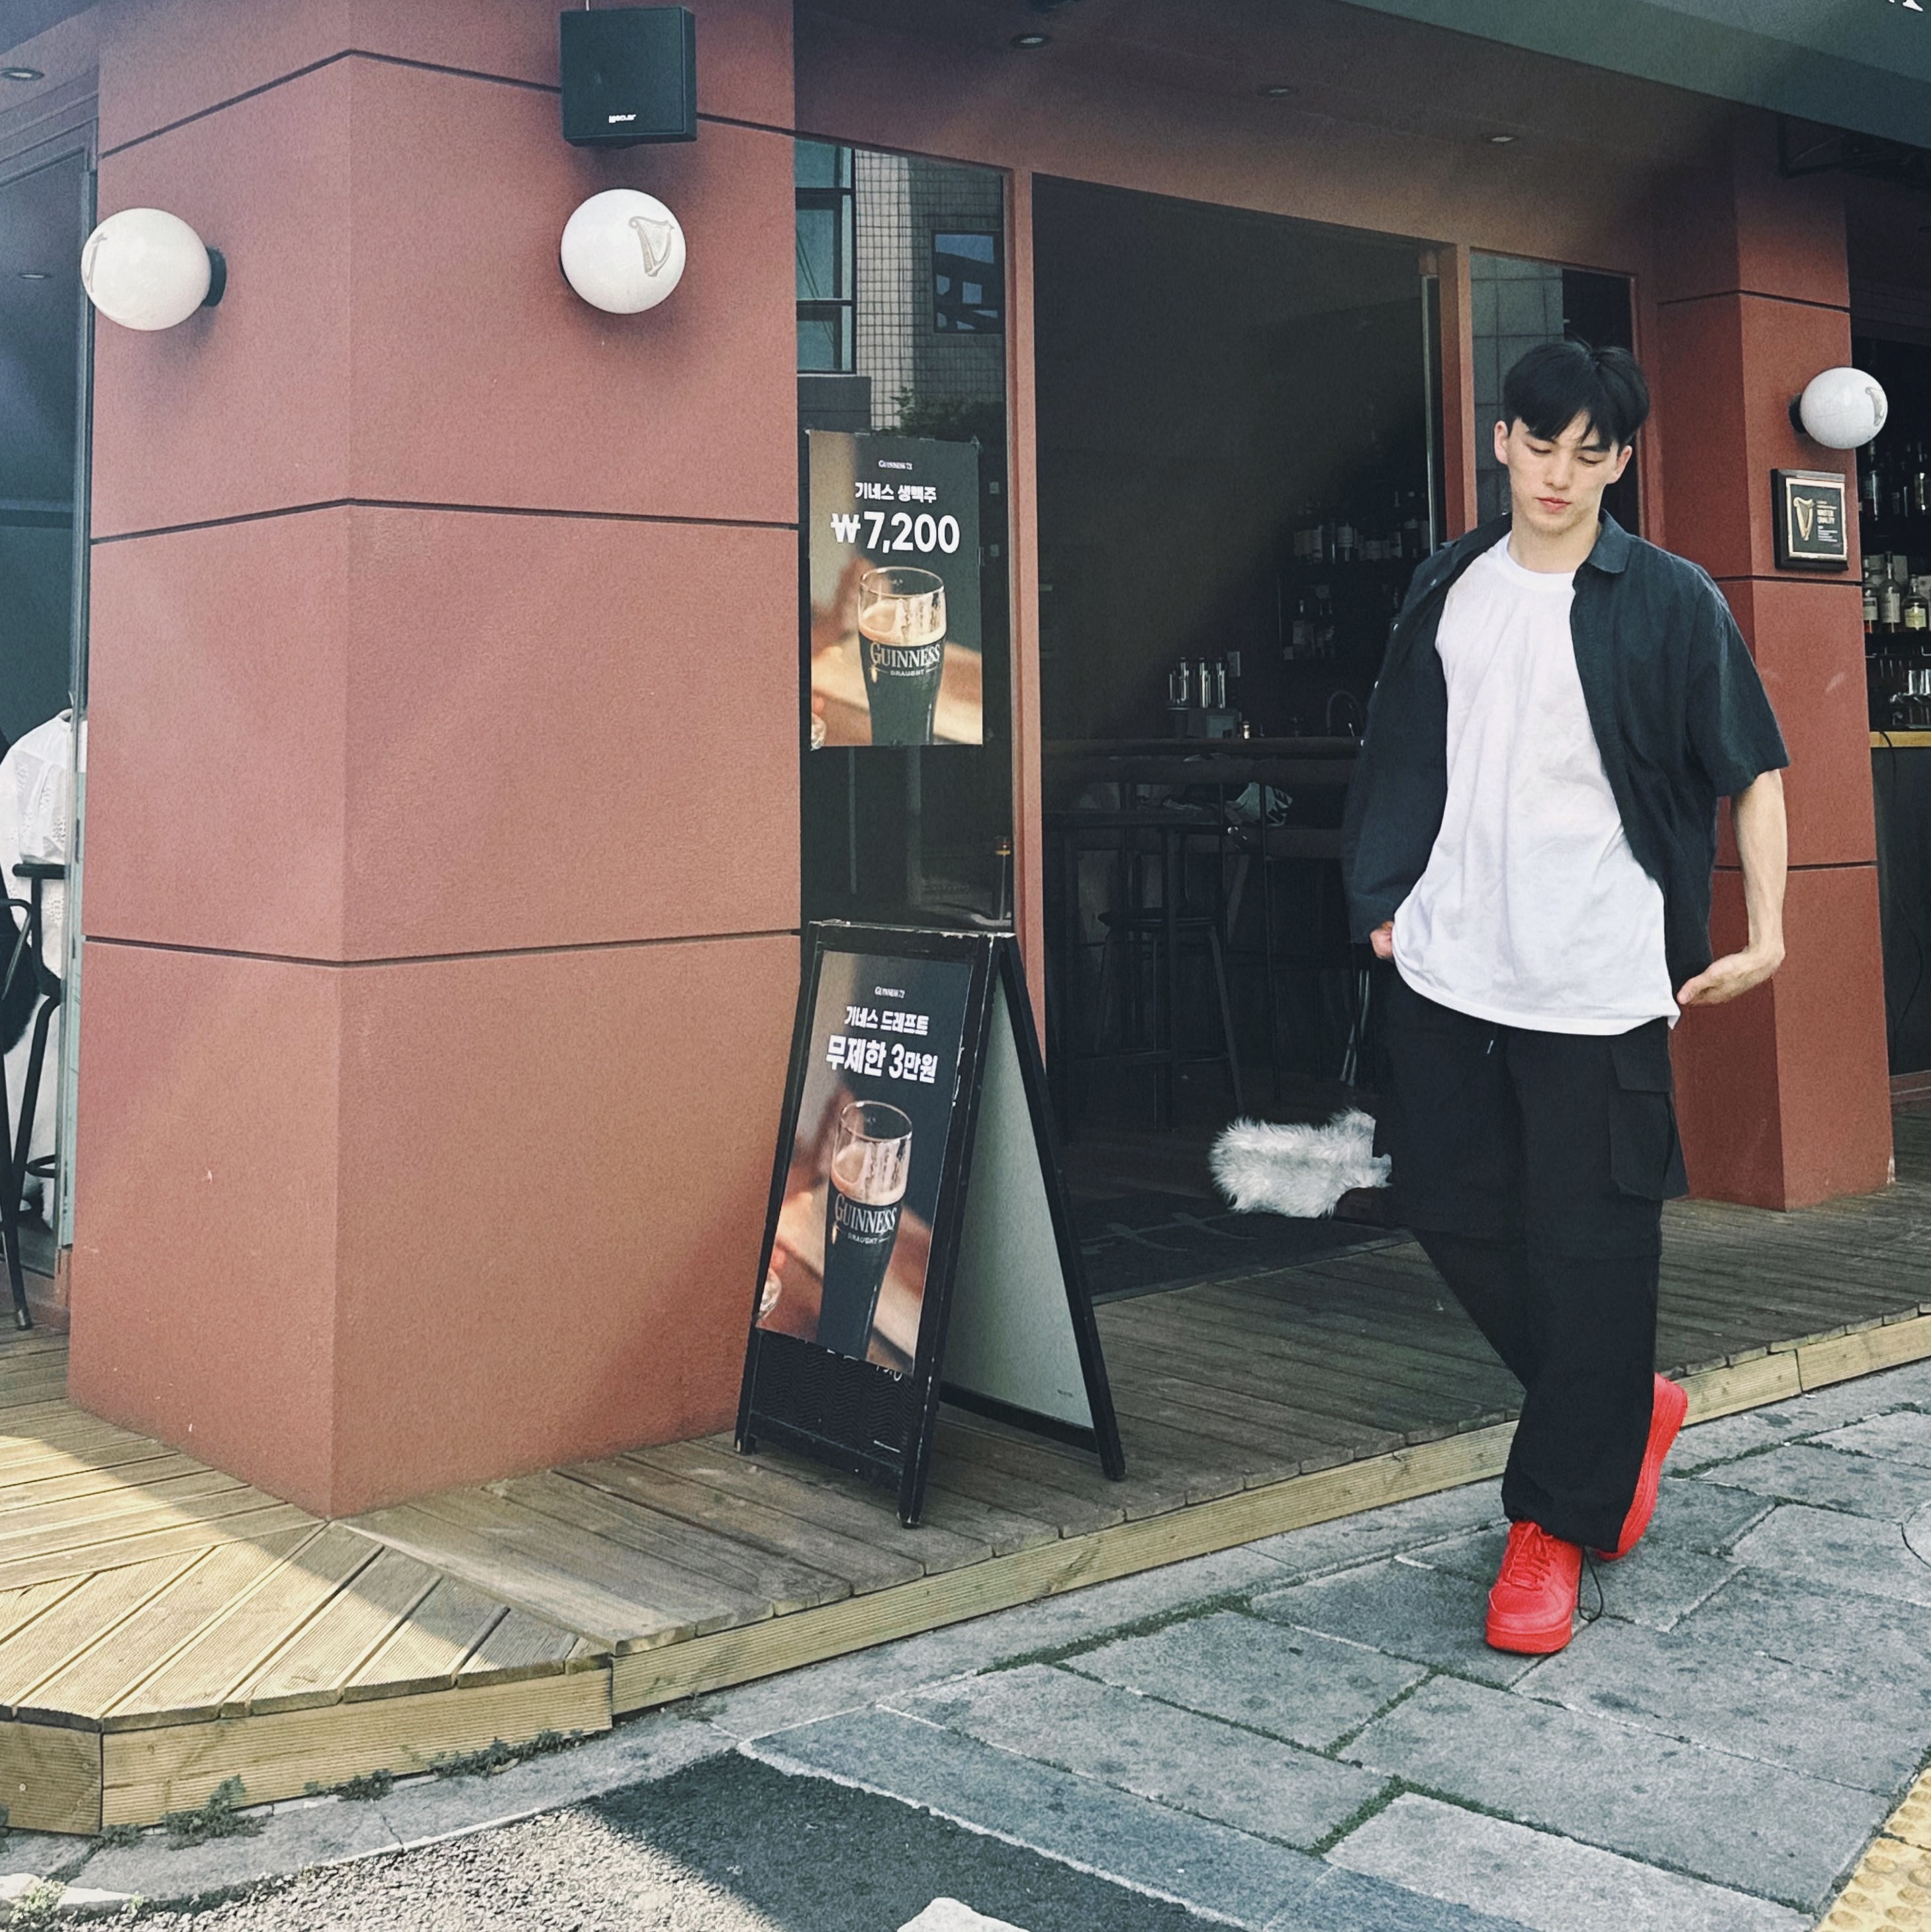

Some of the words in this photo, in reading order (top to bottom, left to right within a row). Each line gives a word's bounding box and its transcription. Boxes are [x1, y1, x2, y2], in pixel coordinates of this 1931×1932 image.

[855, 482, 894, 500] 기네스
[898, 484, 937, 503] 생맥주
[830, 511, 960, 554] ₩7,200
[870, 641, 941, 668] GUINNESS
[844, 1005, 878, 1029] 기네스
[825, 1035, 886, 1077] 무제한
[888, 1043, 938, 1084] 3만원
[835, 1193, 897, 1236] GUINNESS
